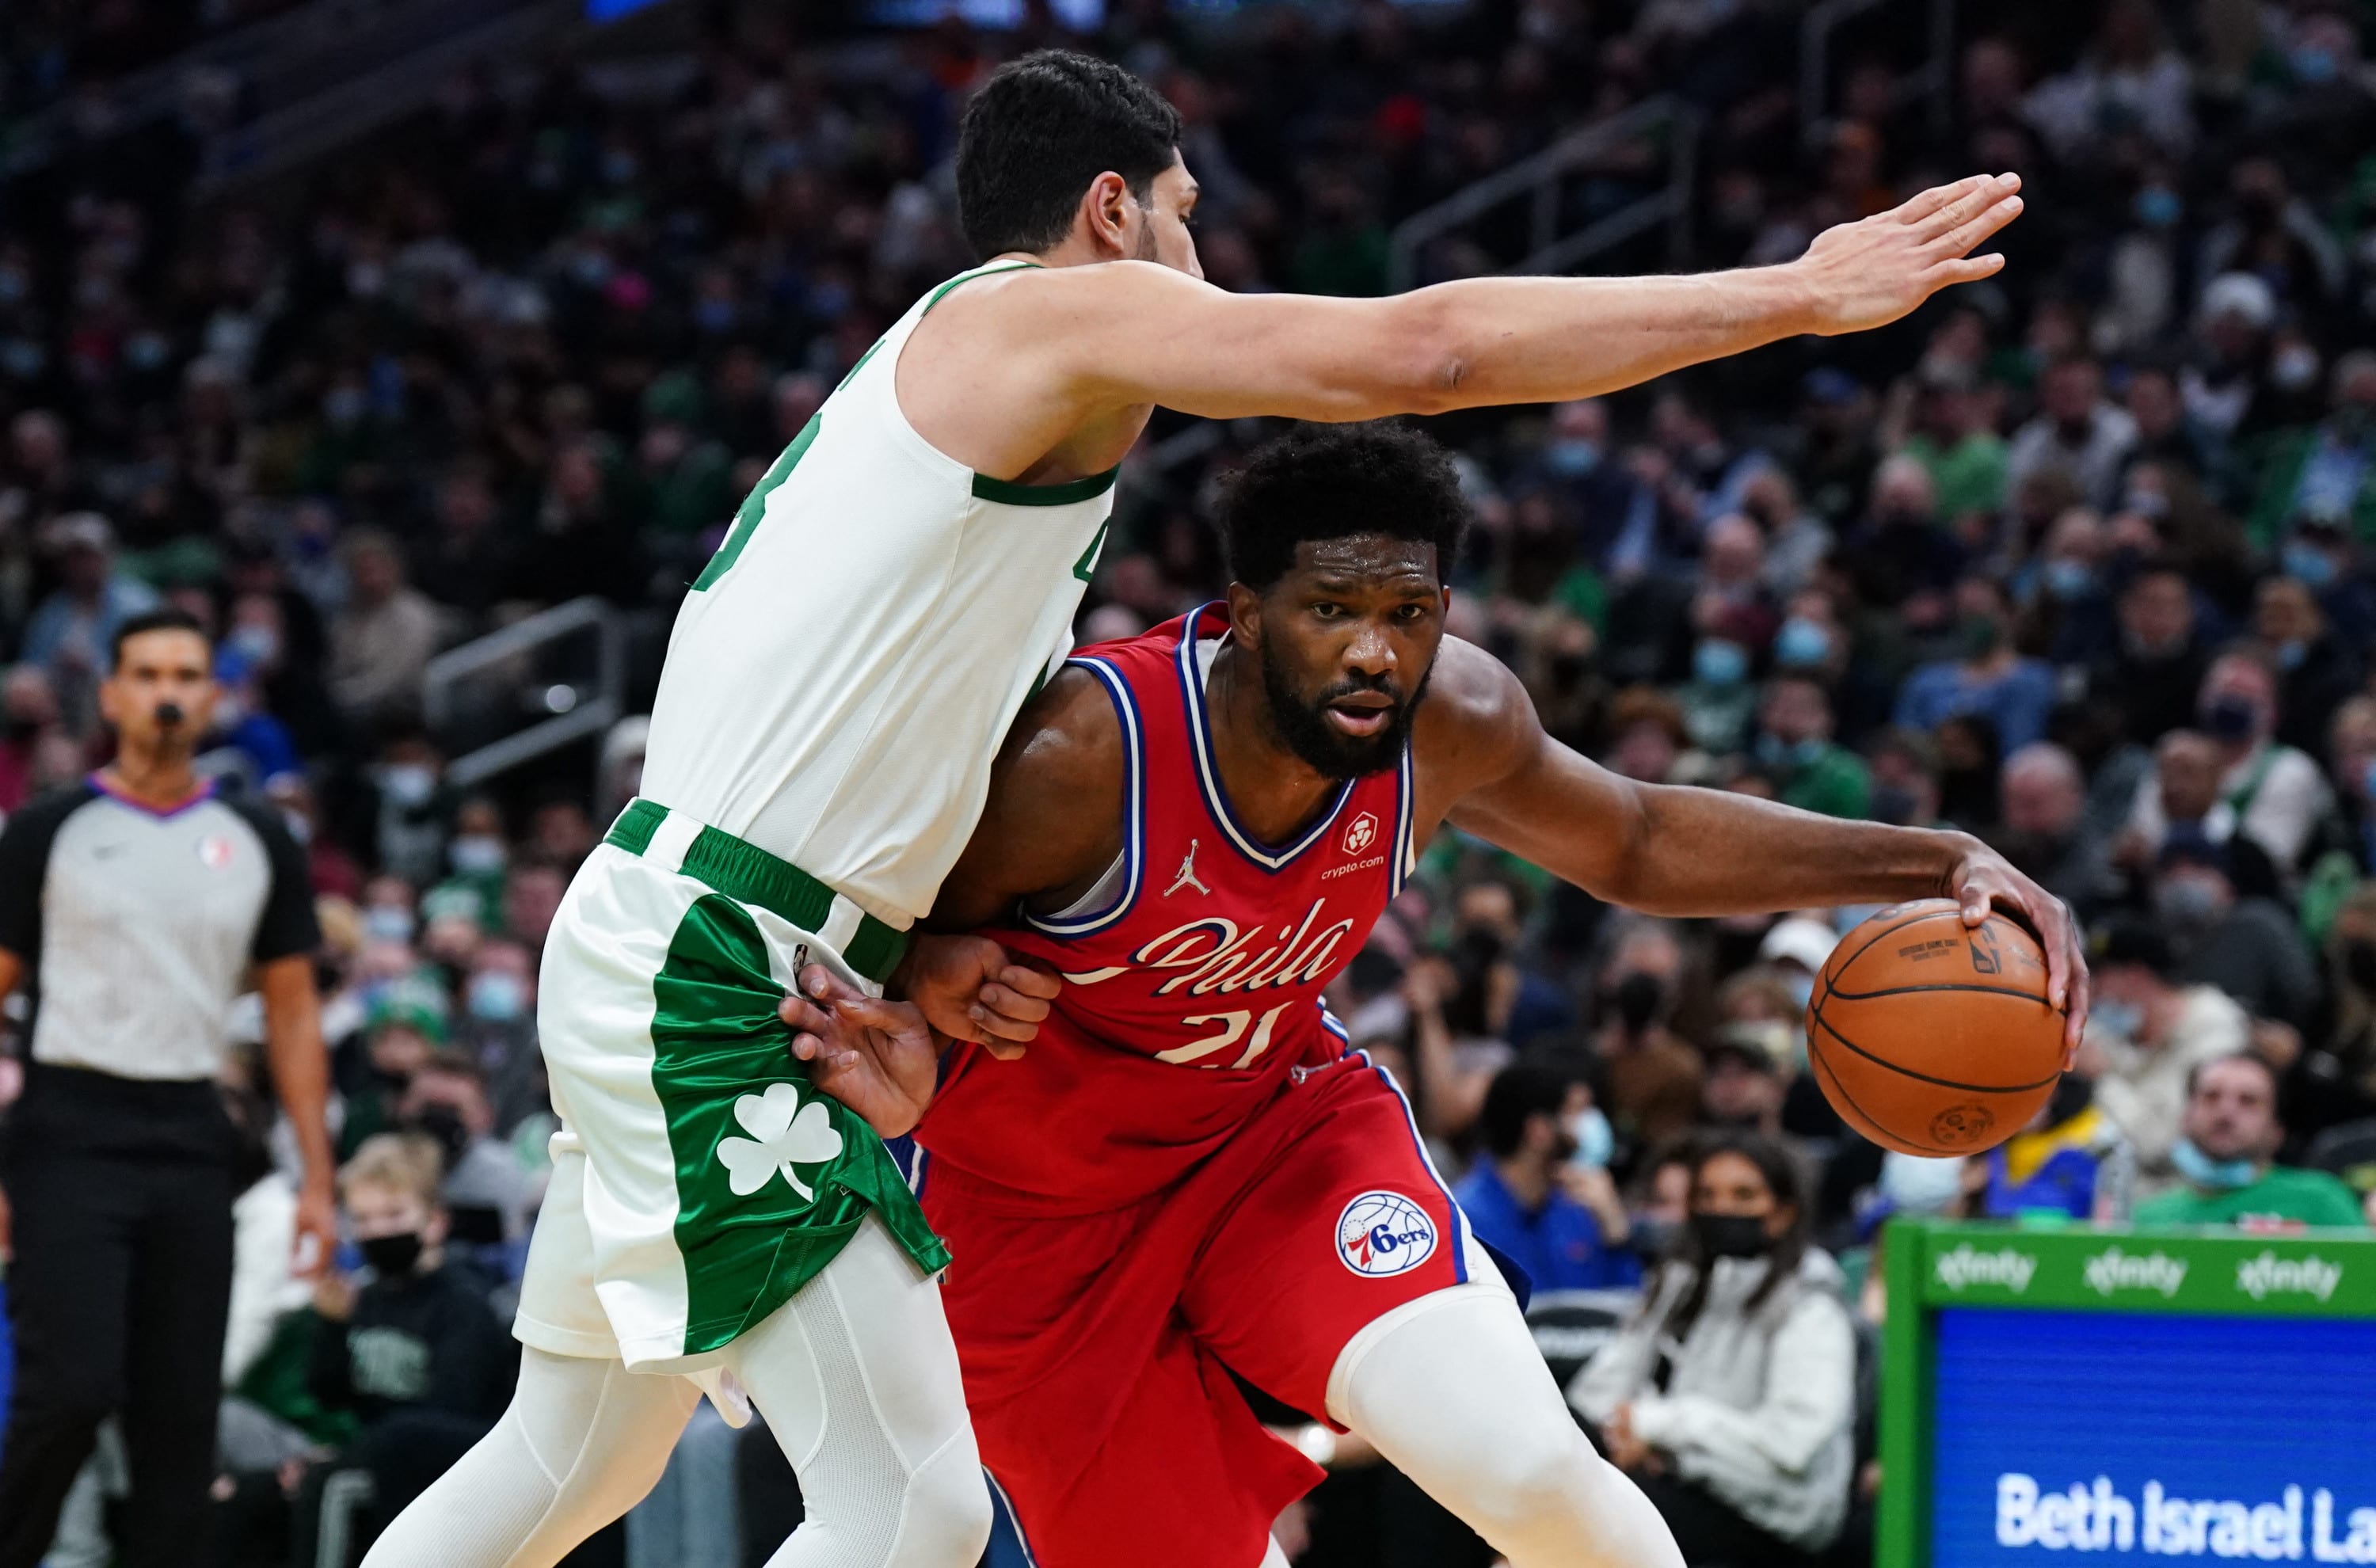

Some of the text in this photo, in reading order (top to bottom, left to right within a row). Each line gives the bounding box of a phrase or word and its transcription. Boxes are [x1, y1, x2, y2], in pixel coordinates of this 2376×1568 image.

[1321, 856, 1384, 880] crypto.com
[1125, 896, 1354, 998] Phila
[1153, 1000, 1294, 1069] 21
[1347, 1224, 1430, 1268] 76ers
[1994, 1471, 2136, 1553] Beth
[2142, 1479, 2304, 1560] Israel
